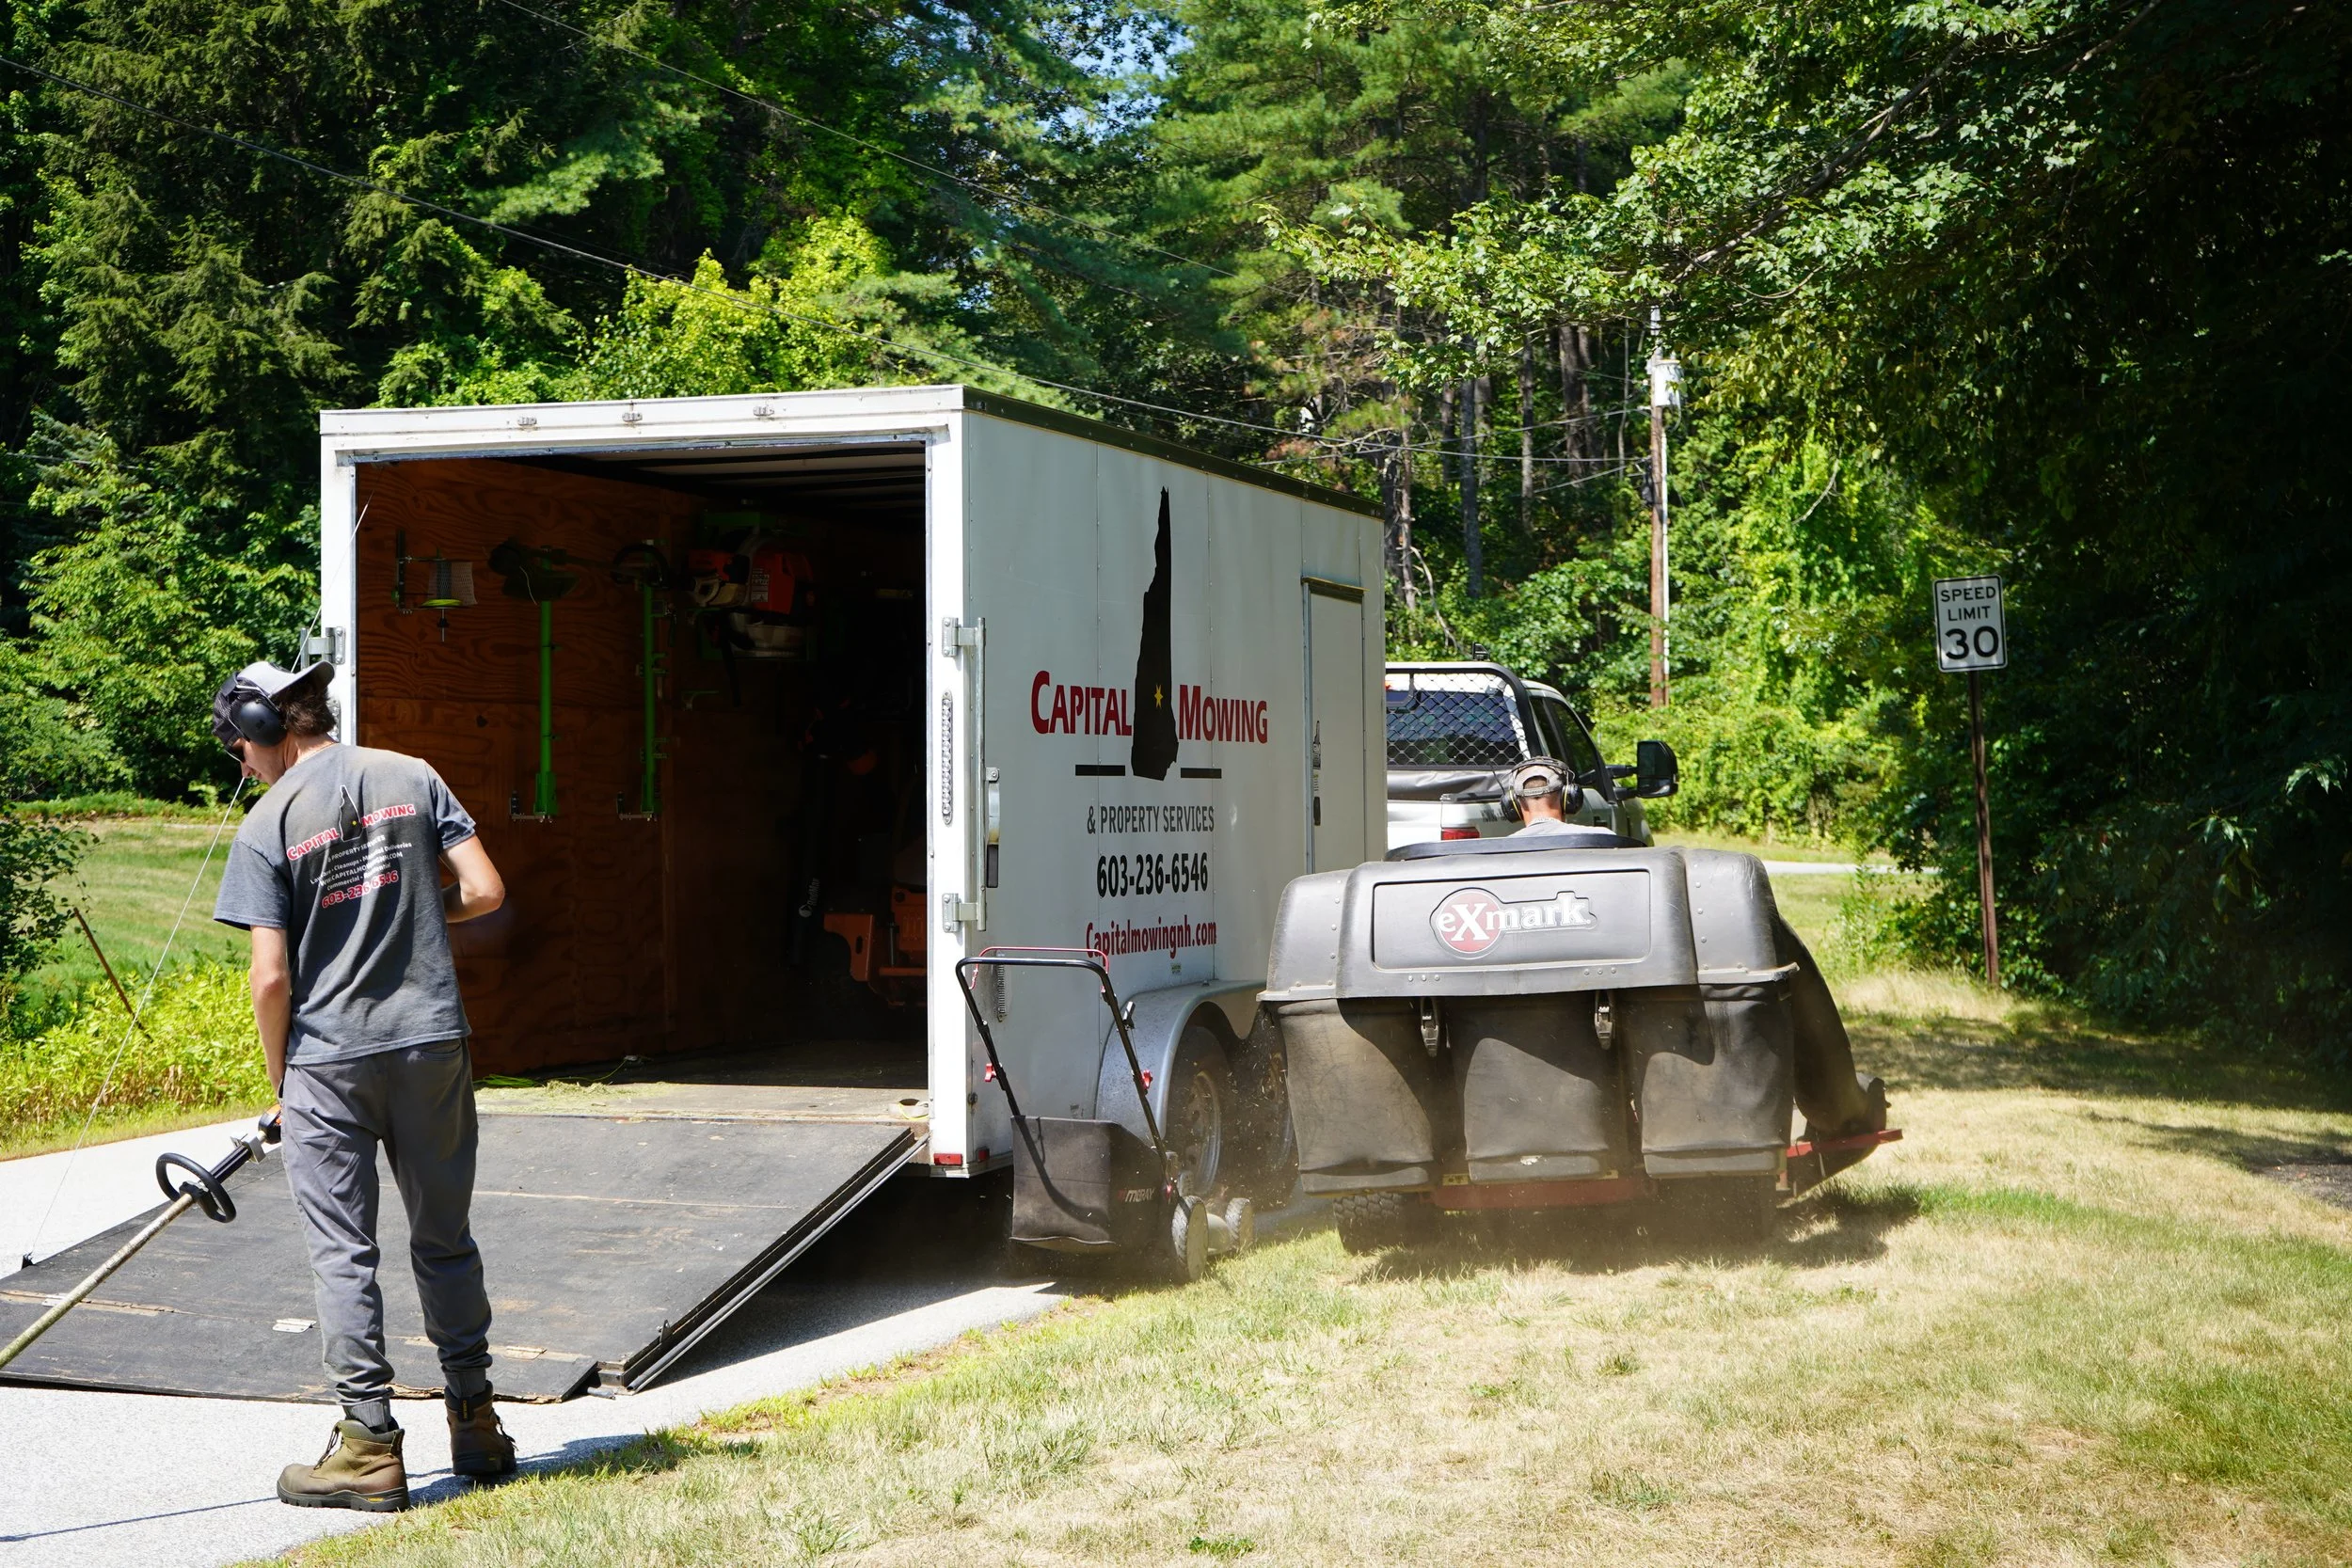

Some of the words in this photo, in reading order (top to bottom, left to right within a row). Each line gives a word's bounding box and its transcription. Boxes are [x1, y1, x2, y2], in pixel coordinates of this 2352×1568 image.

[1941, 586, 1996, 602] SPEED
[1947, 606, 1991, 621] LIMIT
[1945, 626, 1999, 660] 30
[286, 827, 340, 861] CAPITAL
[360, 803, 416, 828] MOWING
[1087, 805, 1096, 834] &
[1100, 805, 1159, 833] PROPERTY
[1163, 805, 1215, 832] SERVICES
[332, 847, 360, 861] PROPERTY
[334, 859, 358, 871] Cleanups
[362, 847, 384, 861] Mial
[363, 863, 391, 879] Rential
[1097, 852, 1208, 897] 603-236-6546
[322, 870, 399, 908] 603-2366546
[1086, 914, 1216, 959] Capitalmowingnh.com
